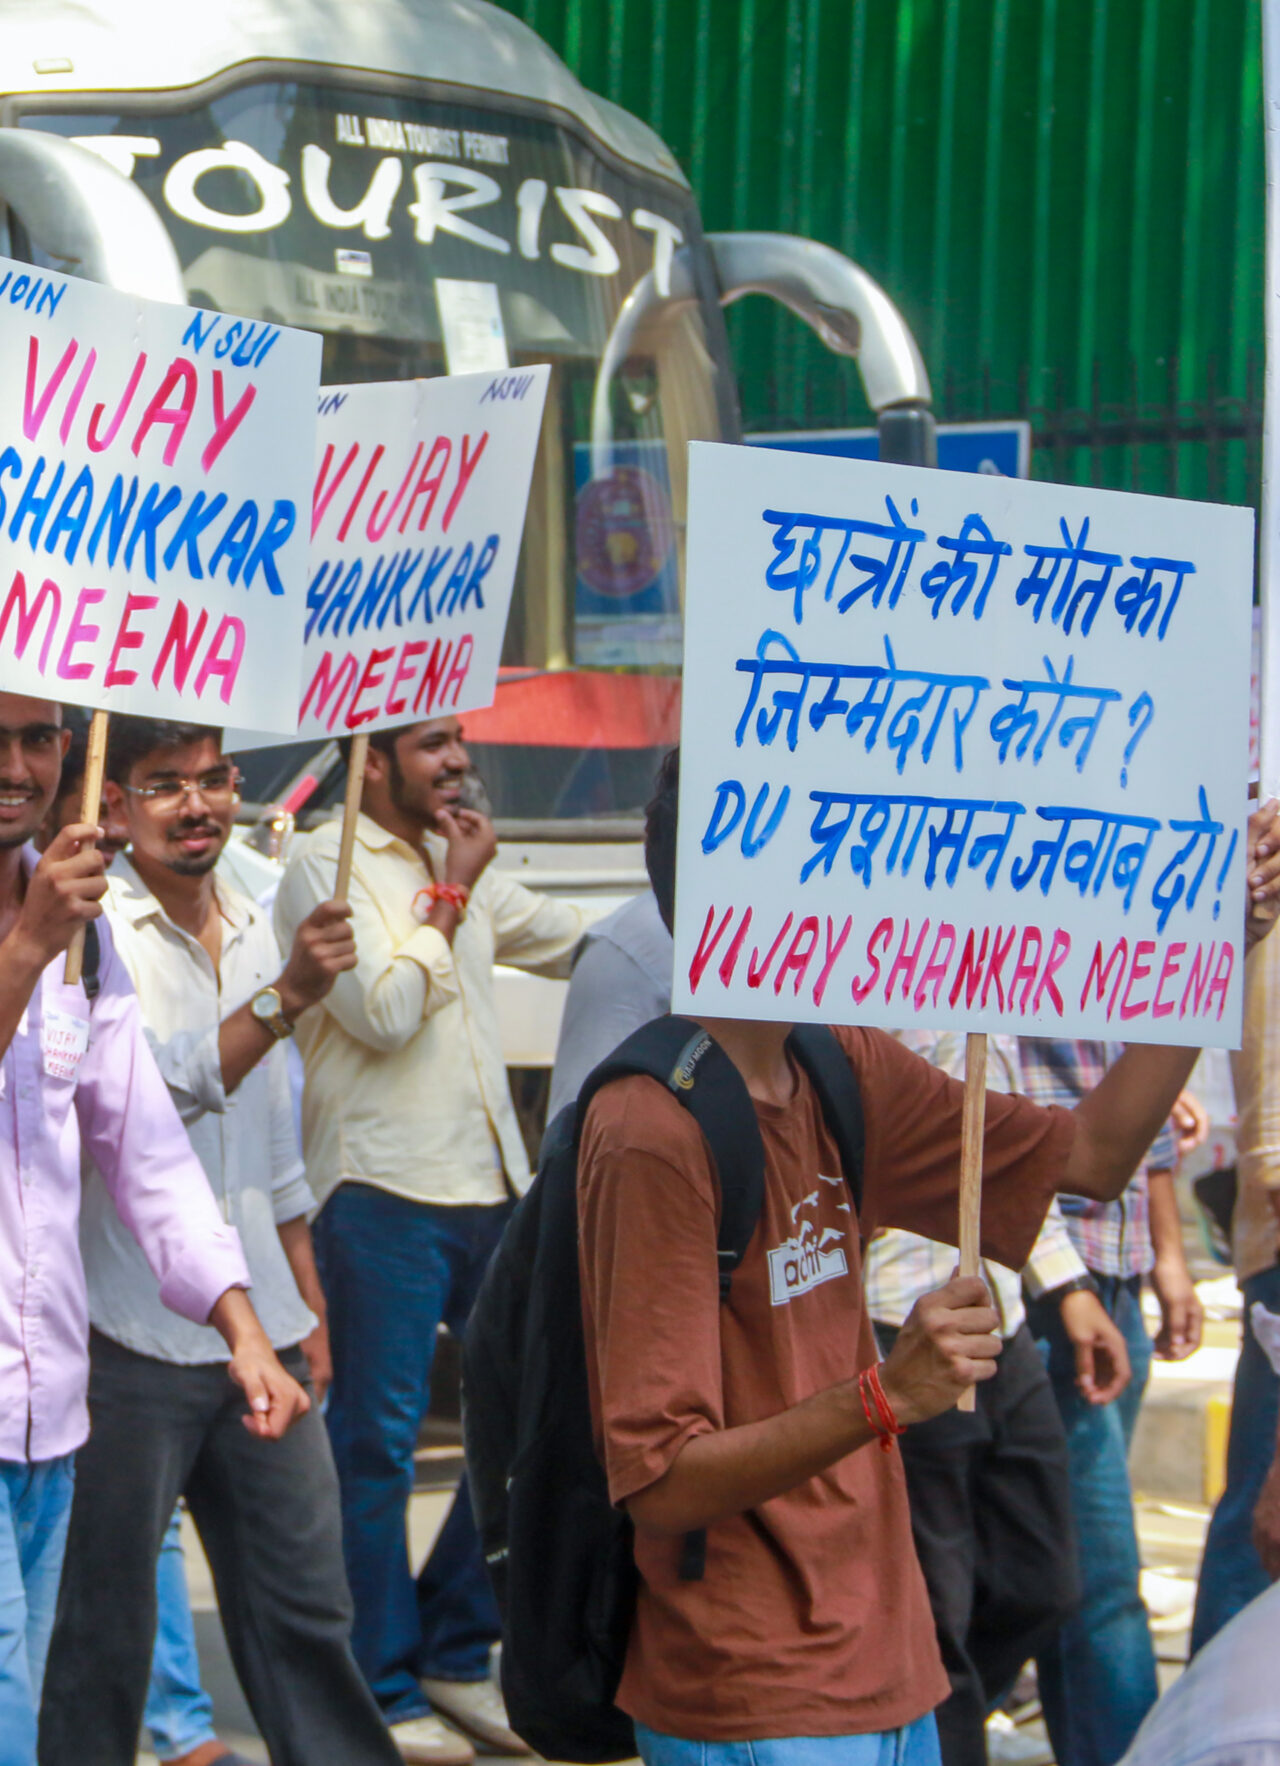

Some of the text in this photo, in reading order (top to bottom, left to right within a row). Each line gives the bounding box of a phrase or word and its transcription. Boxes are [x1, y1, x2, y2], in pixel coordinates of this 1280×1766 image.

[335, 113, 509, 165] ALL INDIA TOURIST PERMIT
[182, 310, 282, 368] NSUI
[22, 335, 258, 475] VIJAY
[310, 430, 489, 543] VIJAY
[304, 533, 500, 646] HANKKAR
[762, 493, 1197, 642] छात्रों की मौत का
[298, 633, 474, 733] MEENA
[734, 628, 992, 776] जिम्मेदार
[700, 779, 792, 859] DU
[799, 790, 1027, 891] प्रशासन
[1009, 804, 1162, 916] जवाब
[686, 904, 1236, 1025] VIJAY SHANKAR MEENA
